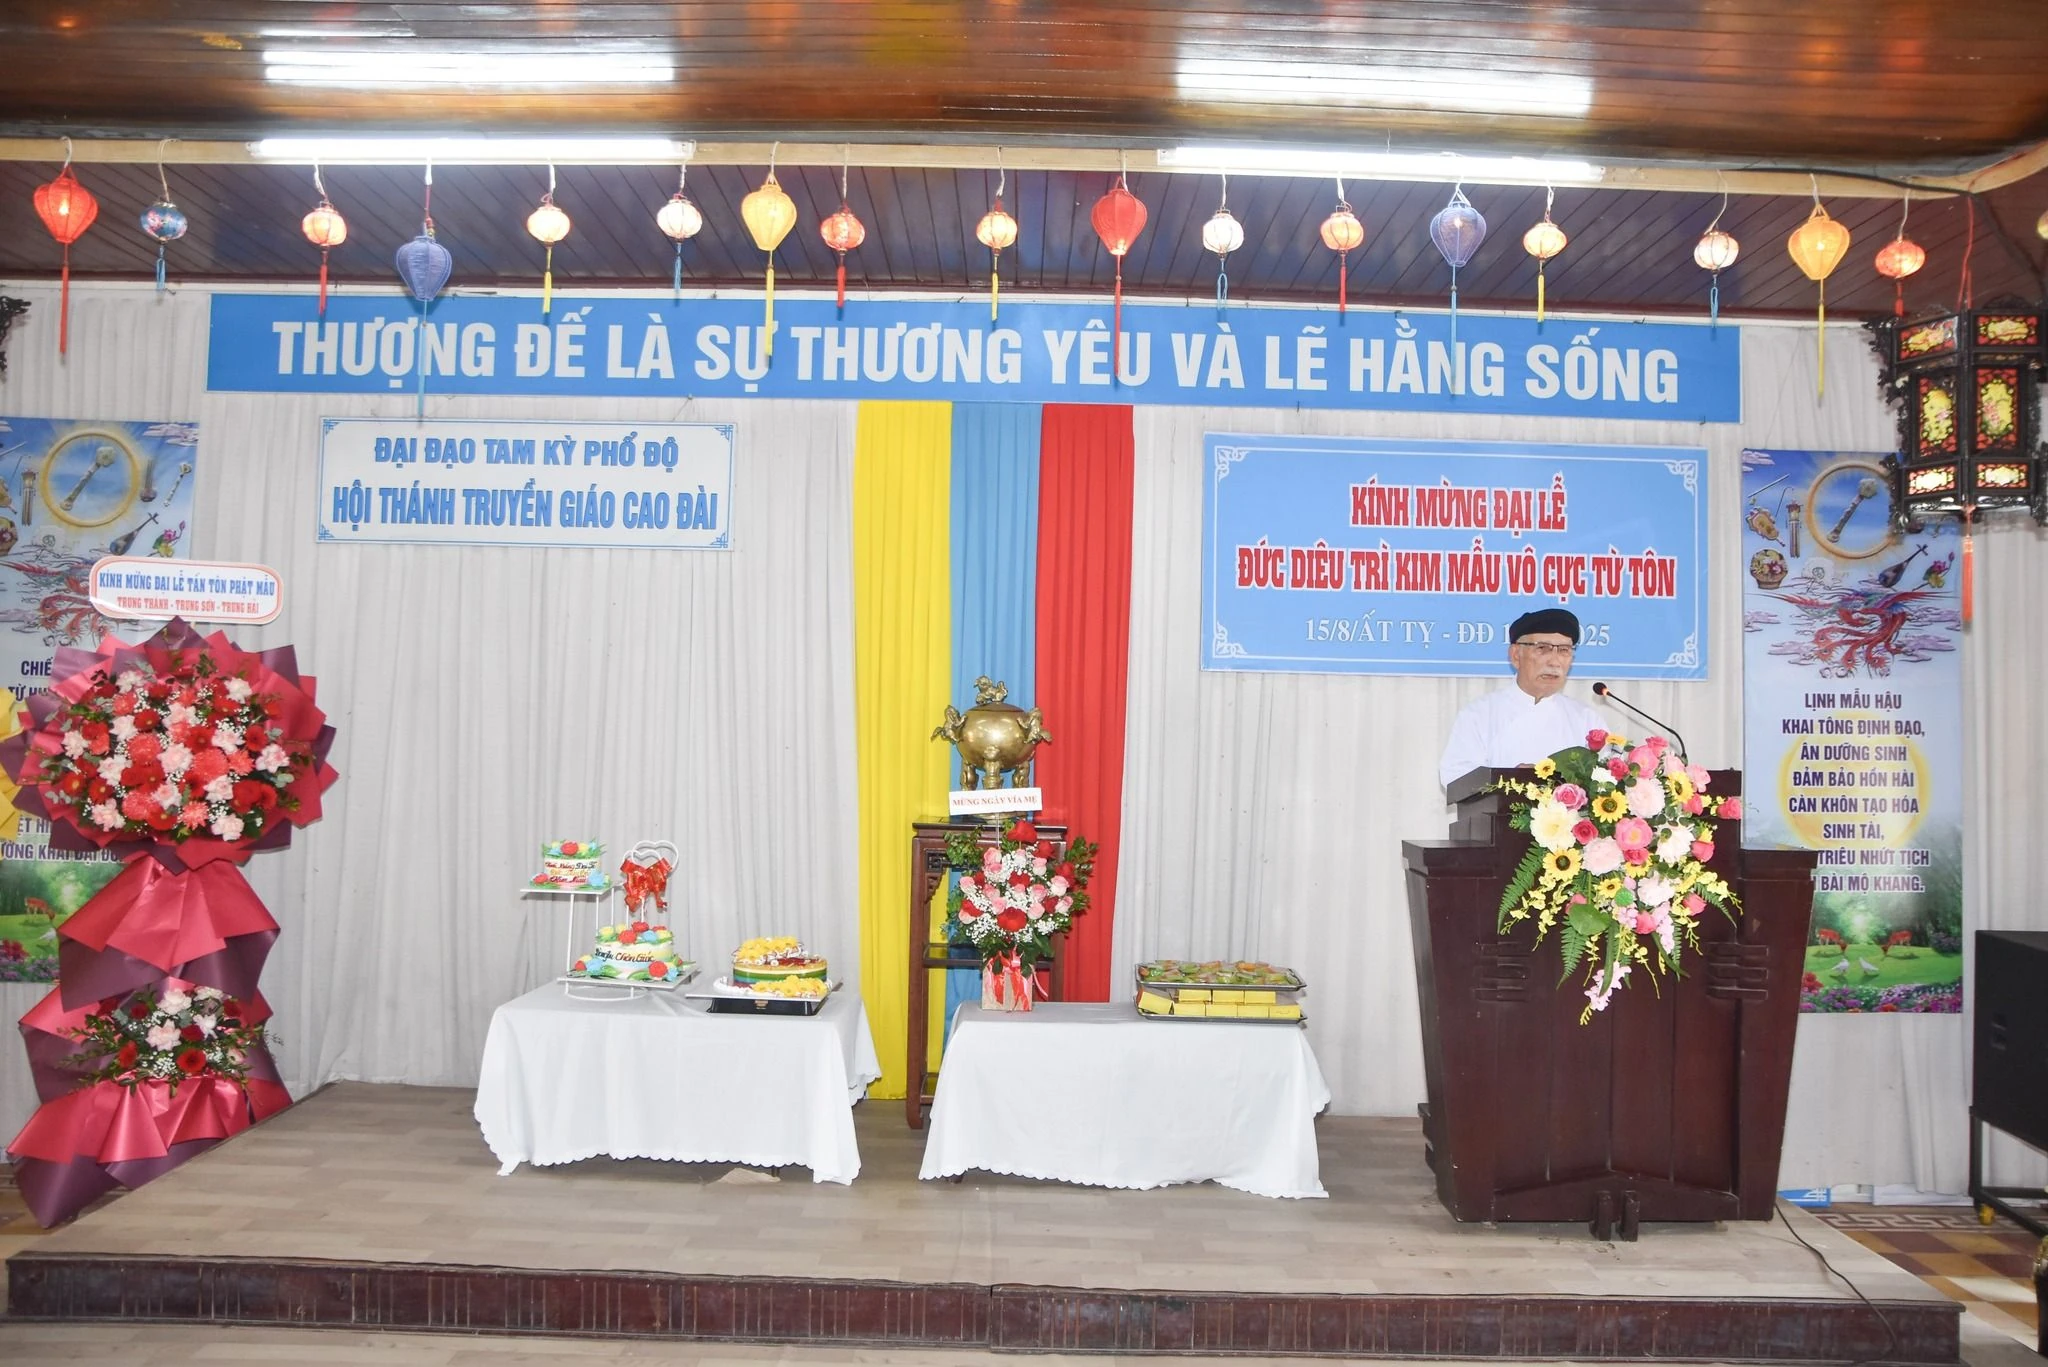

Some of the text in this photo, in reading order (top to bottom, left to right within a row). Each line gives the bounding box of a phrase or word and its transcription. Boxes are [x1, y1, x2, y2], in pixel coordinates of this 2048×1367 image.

[272, 306, 1679, 404] THƯỢNG ĐẾ LÀ SỰ THƯƠNG YÊU VÀ LẼ HẰNG SỐNG
[374, 430, 679, 473] ĐẠI ĐẠO TAM KỲ PHỔ ĐỘ
[332, 477, 719, 531] HỘI THÁNH TRUYỀN GIÁO CAO ĐÀI
[1351, 475, 1566, 537] KÍNH MỪNG ĐẠI LỄ
[1237, 537, 1676, 602] ĐỨC DIÊU TRÌ KIM MẪU VÔ CỰC TỪ TÔN
[99, 569, 123, 589] KÍNH
[125, 570, 152, 590] MỪNG
[154, 575, 170, 594] ĐẠI
[172, 569, 184, 592] LỄ
[229, 576, 254, 599] PHẬT
[256, 574, 275, 596] MẪU
[117, 595, 142, 609] TRUNG
[175, 599, 200, 612] TRUNG
[221, 601, 245, 614] TRUNG
[1304, 609, 1393, 643] 15/8/ẤT
[1400, 621, 1436, 648] TỴ
[1457, 622, 1494, 645] ĐĐ
[20, 656, 53, 676] CHIẾ
[1804, 688, 1903, 712] LỊNH MẪU HẬU
[1782, 716, 1926, 738] KHAI TÔNG ĐỊNH ĐẠO,
[1800, 742, 1907, 761] ÂN DƯỠNG SINH
[1793, 766, 1824, 787] ĐẢM
[1828, 766, 1855, 787] BẢO
[1788, 794, 1920, 816] CÀN KHÔN TẠO HÓA
[1823, 823, 1856, 839] SINH
[1818, 846, 1930, 869] TRIÊU NHỨT TỊCH
[1821, 872, 1844, 891] BÀI
[1848, 872, 1869, 894] MỘ
[1873, 875, 1925, 891] KHANG.
